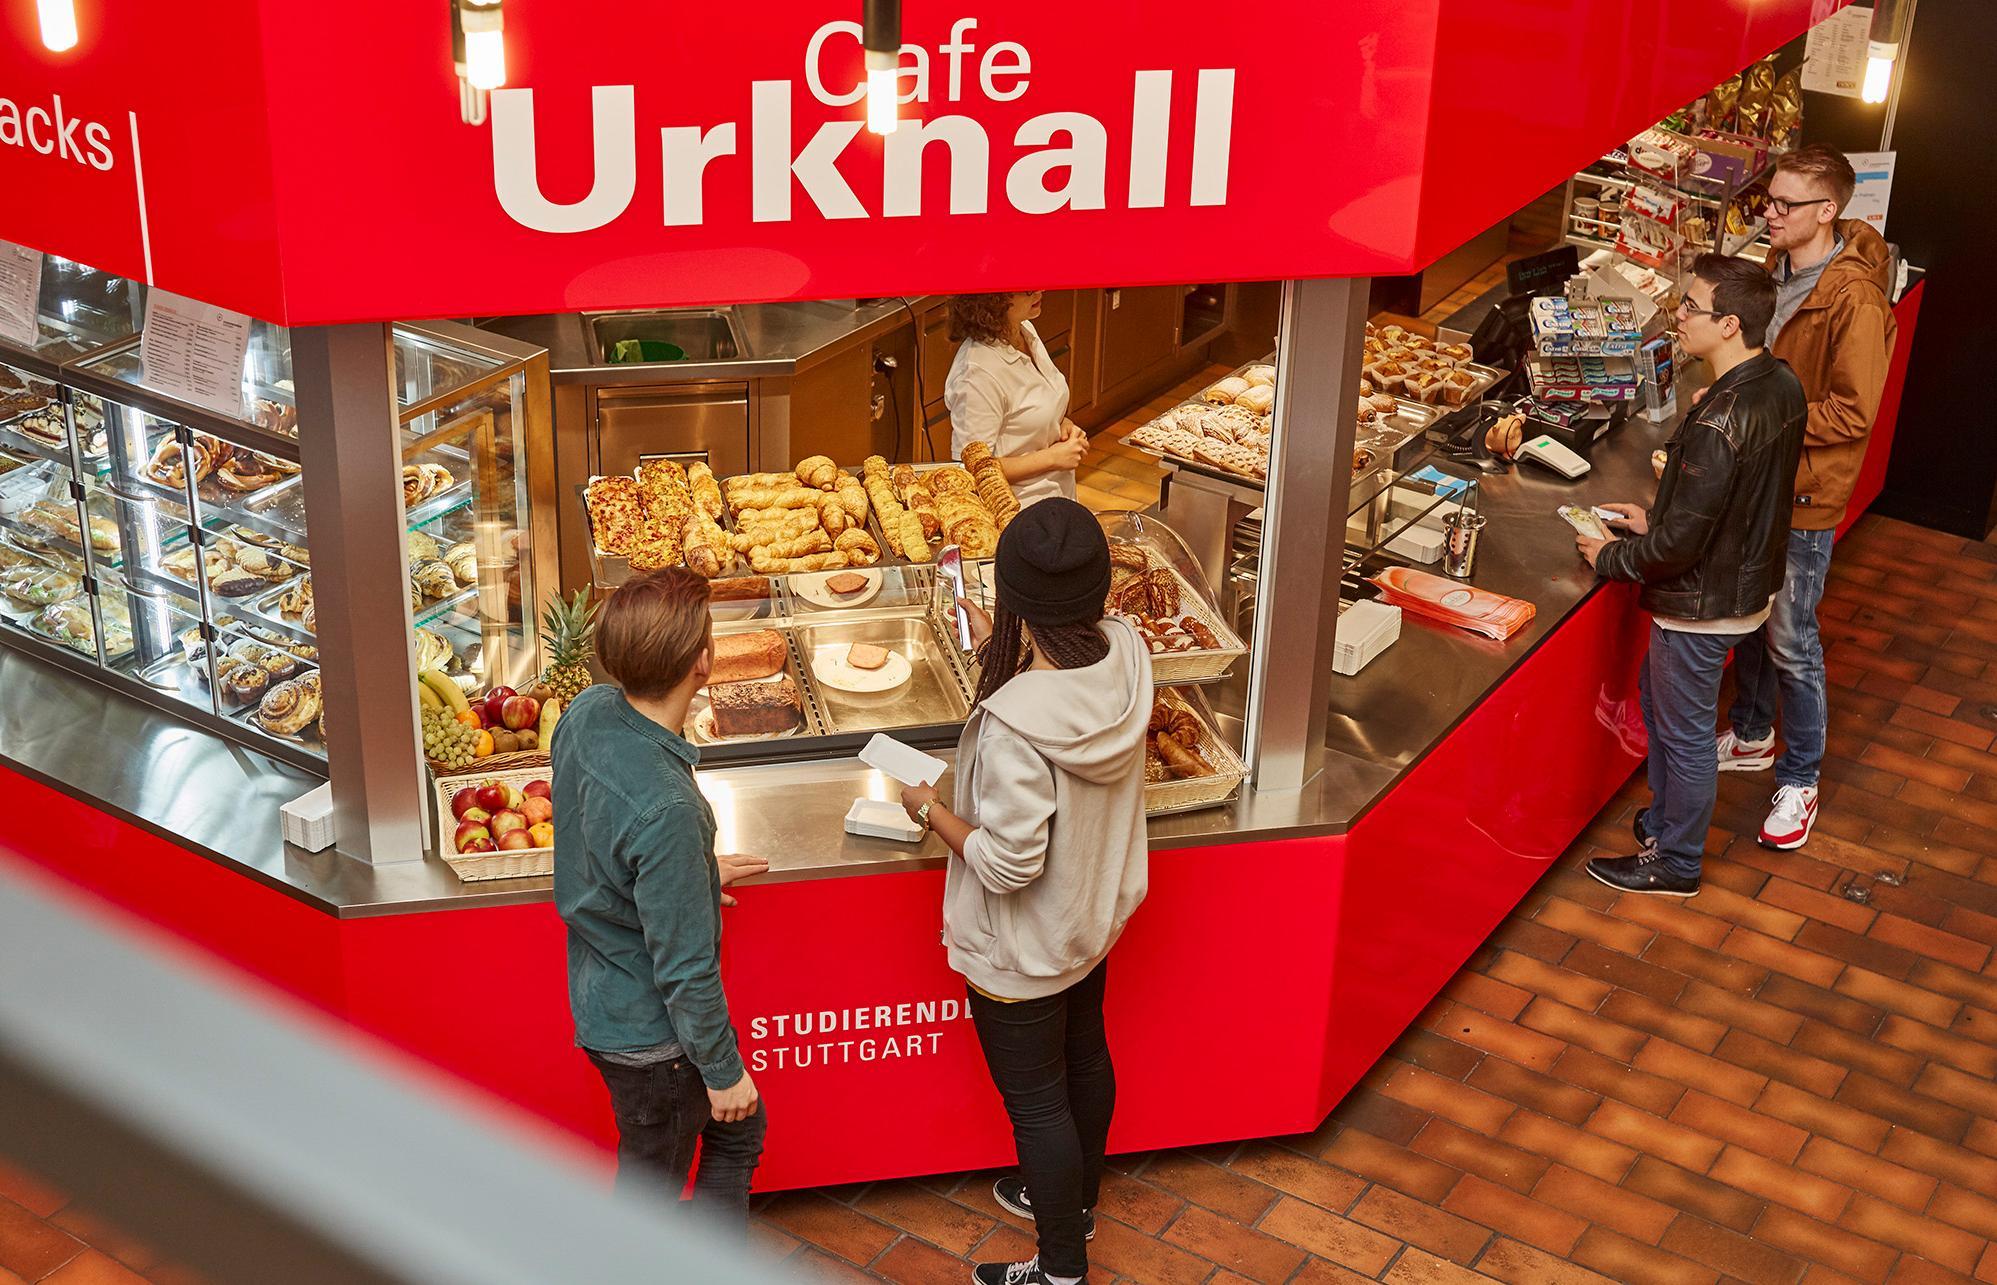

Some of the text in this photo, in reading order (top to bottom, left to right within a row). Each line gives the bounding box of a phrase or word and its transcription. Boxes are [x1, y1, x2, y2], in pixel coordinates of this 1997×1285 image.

[804, 17, 1032, 107] Cafe
[490, 68, 1236, 234] Urknall
[751, 1032, 944, 1072] STUTTGART
